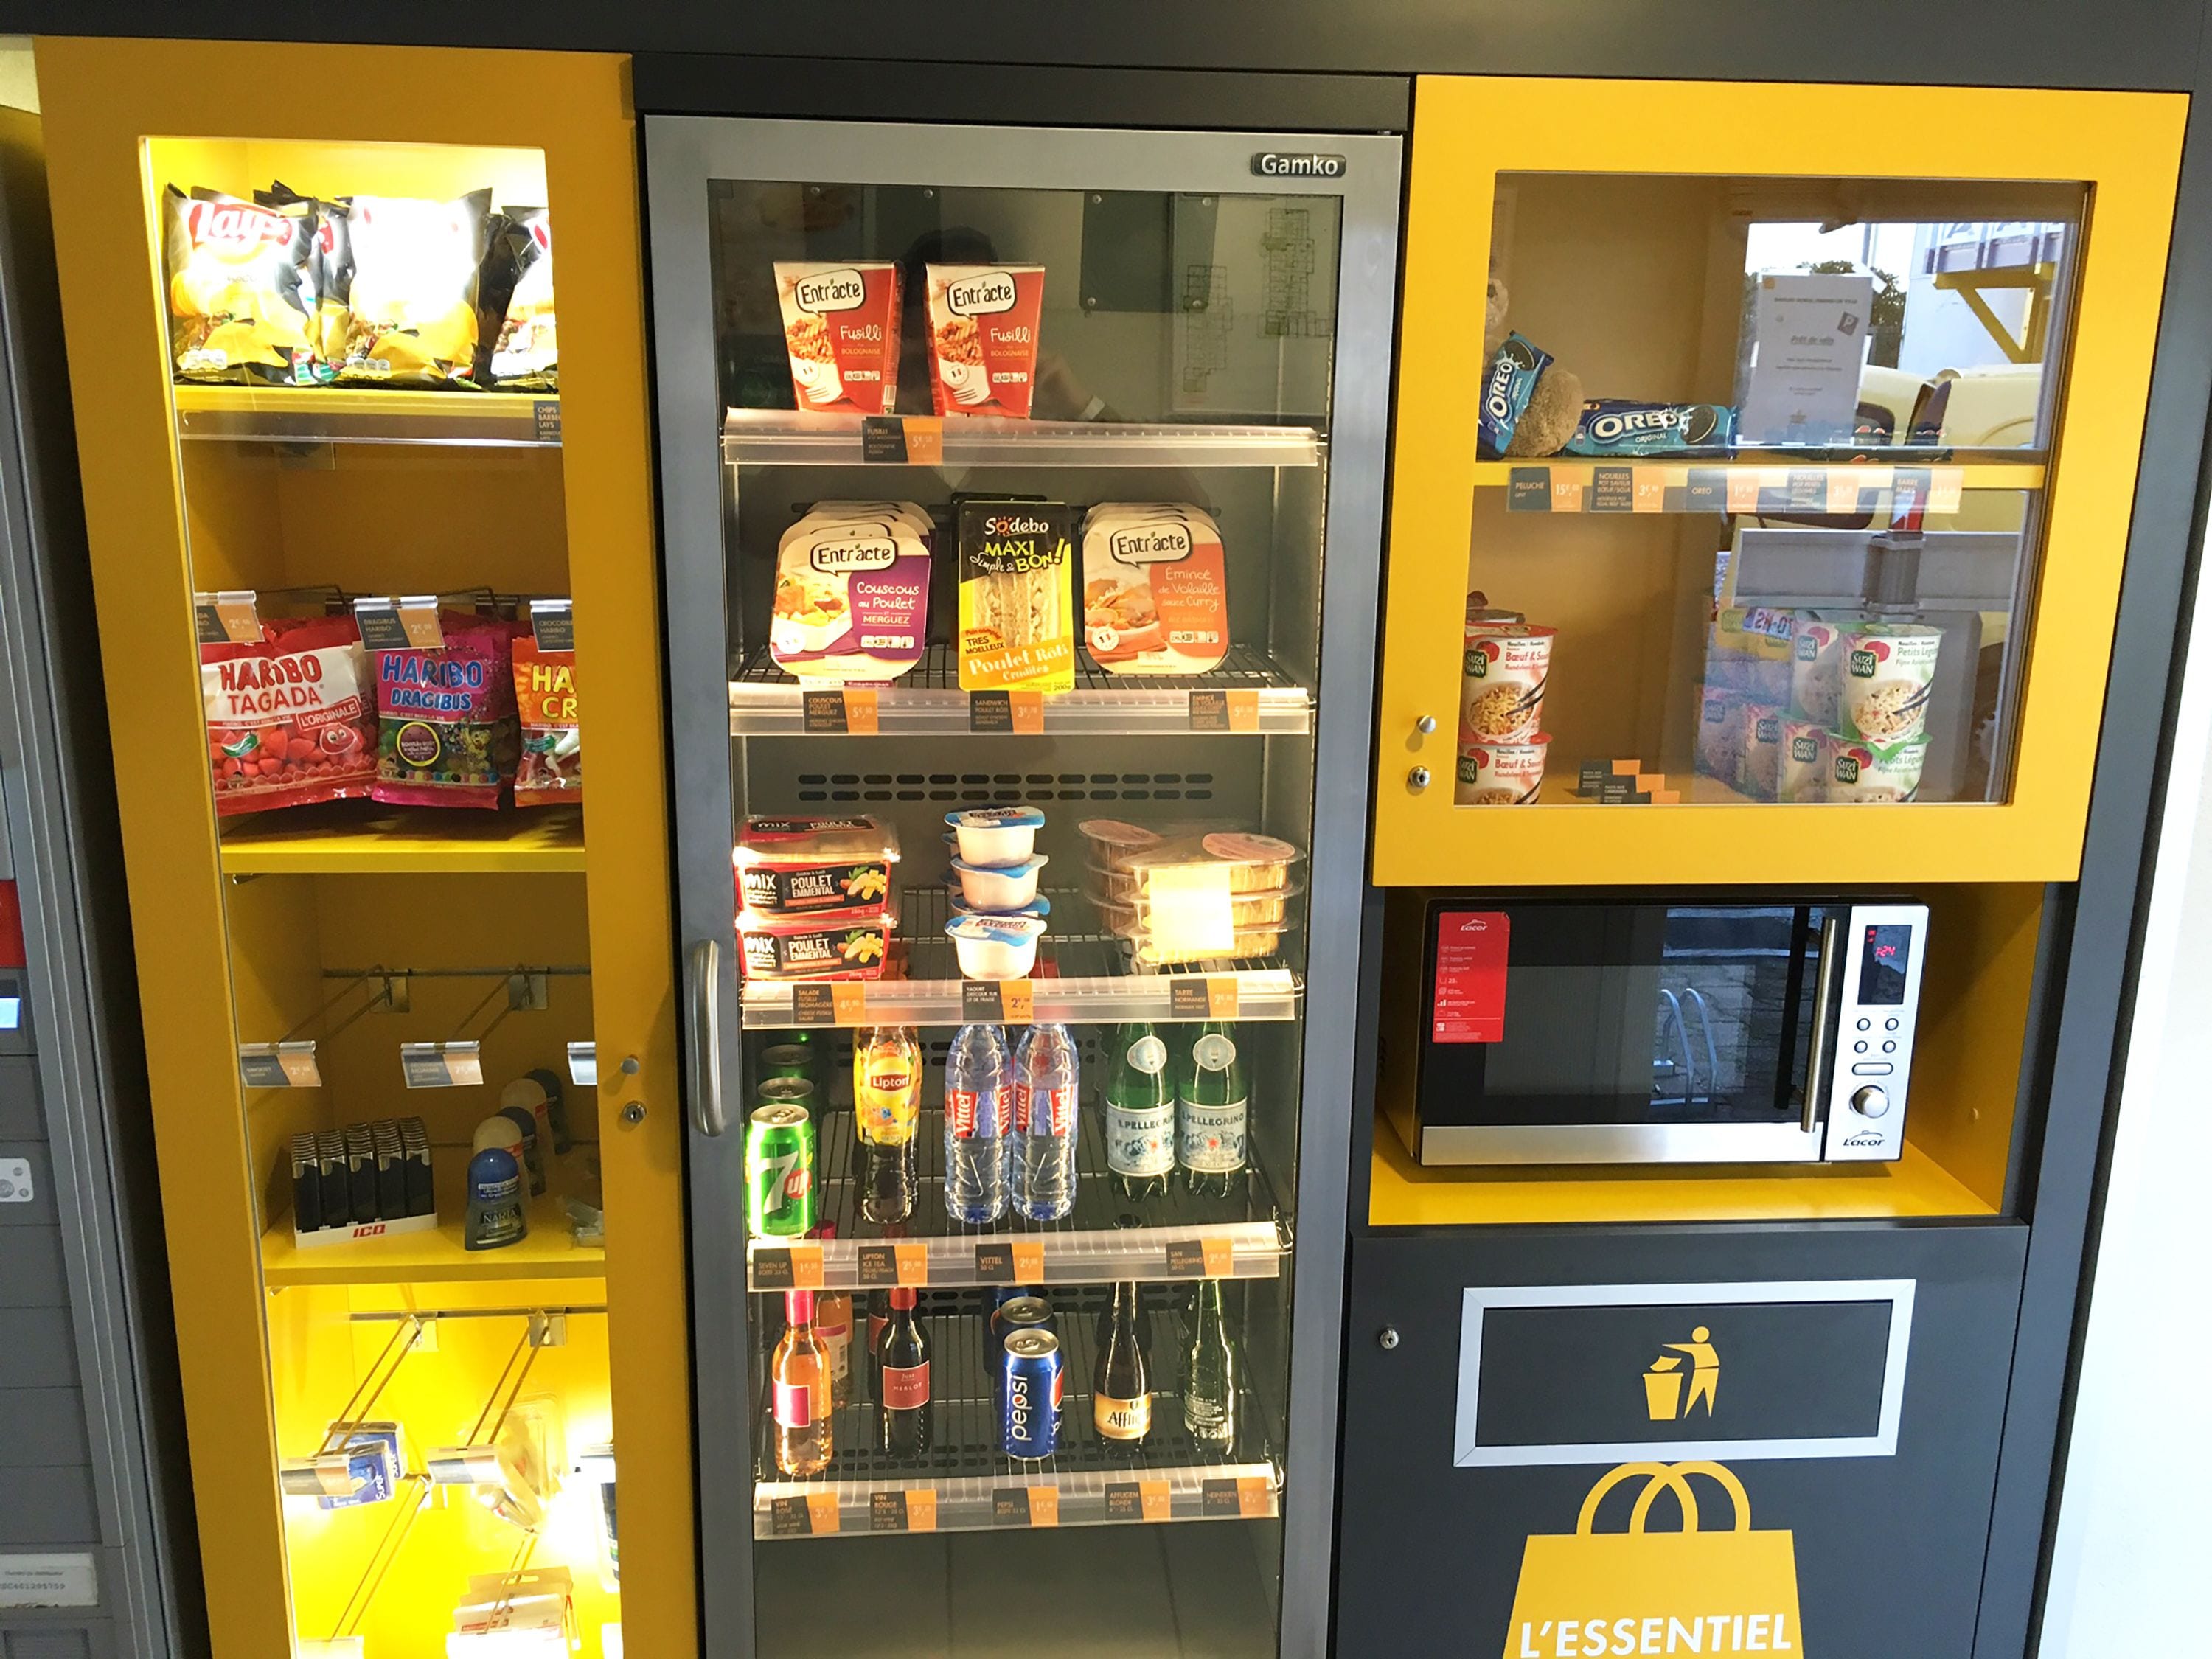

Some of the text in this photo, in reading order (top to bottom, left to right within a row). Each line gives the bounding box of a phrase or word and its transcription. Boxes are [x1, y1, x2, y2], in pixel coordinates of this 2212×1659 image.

[1261, 153, 1338, 176] Gamko
[840, 325, 882, 341] Fusilli
[990, 327, 1030, 343] Fusilli
[1488, 363, 1513, 418] OREO
[1593, 411, 1678, 439] OREO
[1635, 434, 1668, 443] ORIGINAL
[985, 541, 1035, 557] MAXI
[856, 582, 920, 595] Couscous
[1171, 582, 1221, 596] Volaille
[873, 597, 915, 610] Poulet
[1186, 595, 1220, 613] Curry
[863, 616, 910, 625] MERGUEZ
[965, 642, 1005, 655] MOELLEUX
[966, 636, 990, 647] TRES
[969, 643, 1069, 676] Poulet Rôti
[218, 654, 324, 692] HARIBO
[381, 655, 484, 688] HARIBO
[1851, 665, 1873, 675] WAN
[227, 686, 323, 715] TAGADA
[391, 687, 473, 711] DRAGIBUS
[300, 701, 358, 727] L'ORIGINALE
[1836, 770, 1857, 780] WAN
[790, 874, 832, 889] POULET
[793, 886, 835, 898] EMMENTAL
[788, 938, 829, 953] POULET
[790, 950, 832, 961] EMMENTAL
[872, 1076, 909, 1089] Lipton
[956, 1093, 973, 1135] Vittel
[1842, 1135, 1885, 1148] Lacor
[760, 1150, 799, 1215] 7
[893, 1382, 923, 1392] MERLOT
[1011, 1374, 1032, 1441] pepsi
[1520, 1613, 1792, 1658] L'ESSENTIEL
